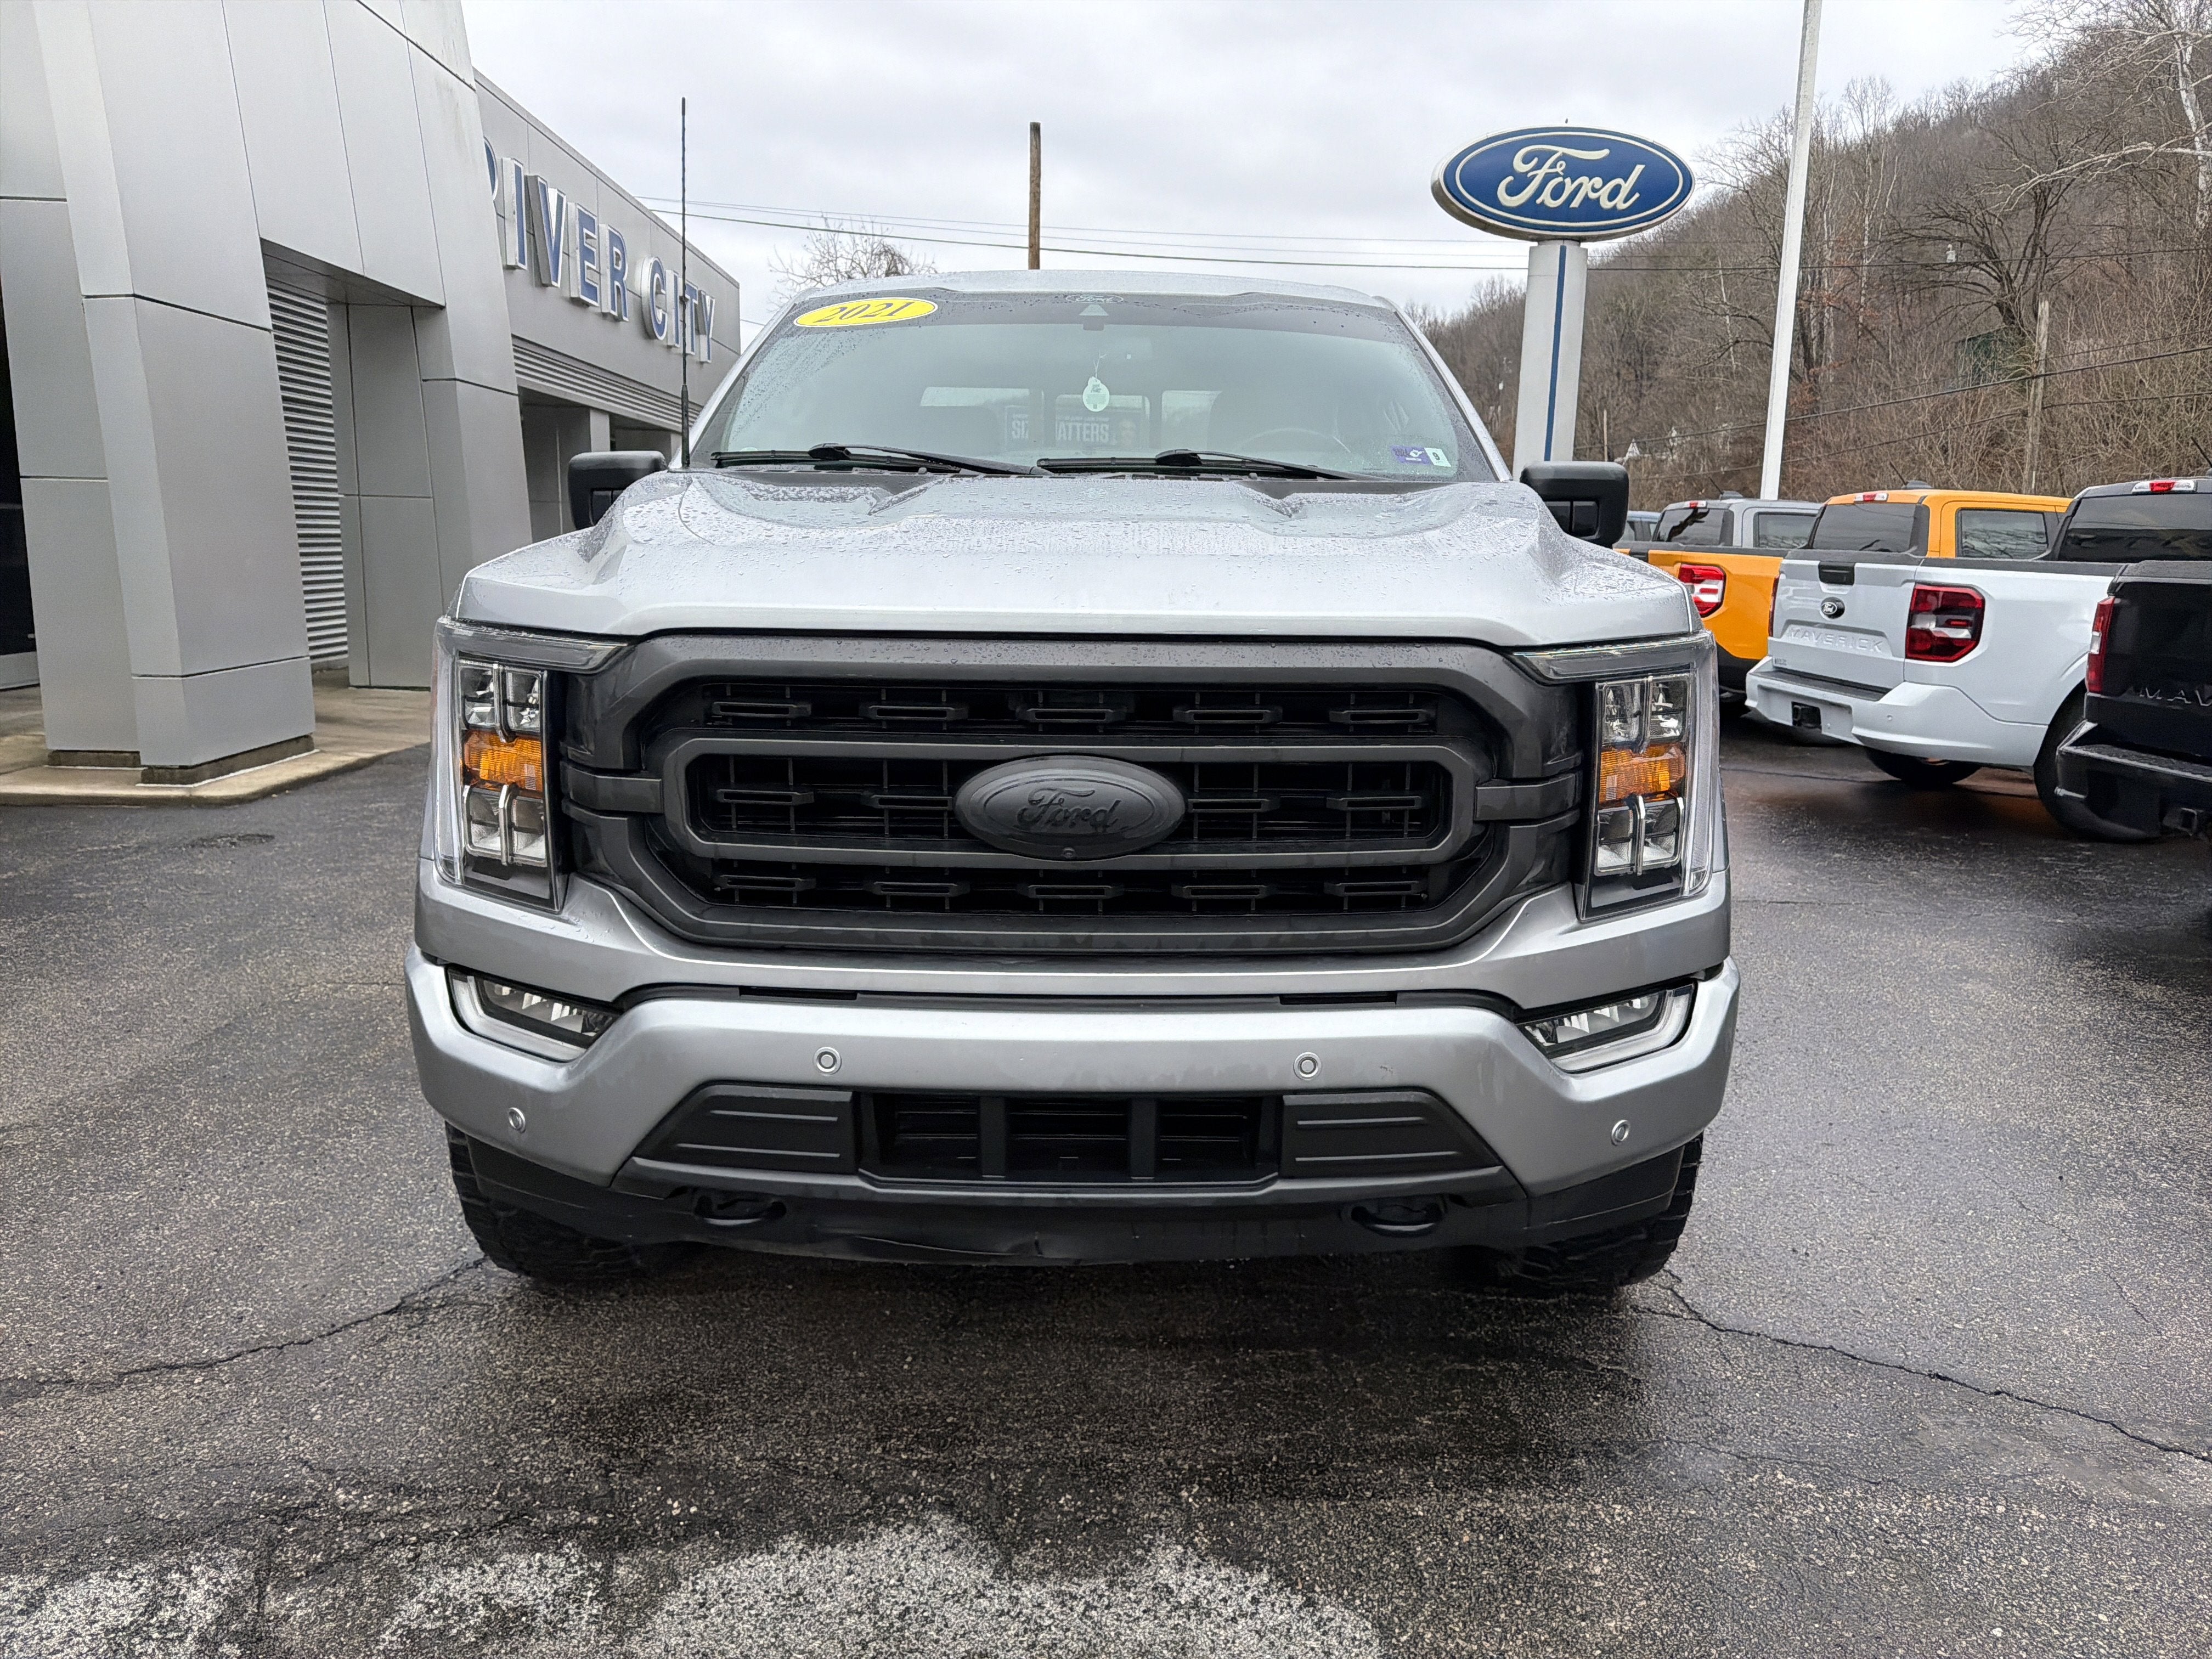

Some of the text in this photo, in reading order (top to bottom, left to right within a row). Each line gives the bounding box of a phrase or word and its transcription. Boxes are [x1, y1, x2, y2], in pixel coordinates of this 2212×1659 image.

[1497, 144, 1646, 210] Ford
[639, 255, 715, 364] CITY
[812, 301, 916, 324] 2021
[1789, 628, 1883, 653] MAVERICK
[1017, 787, 1121, 831] Ford
